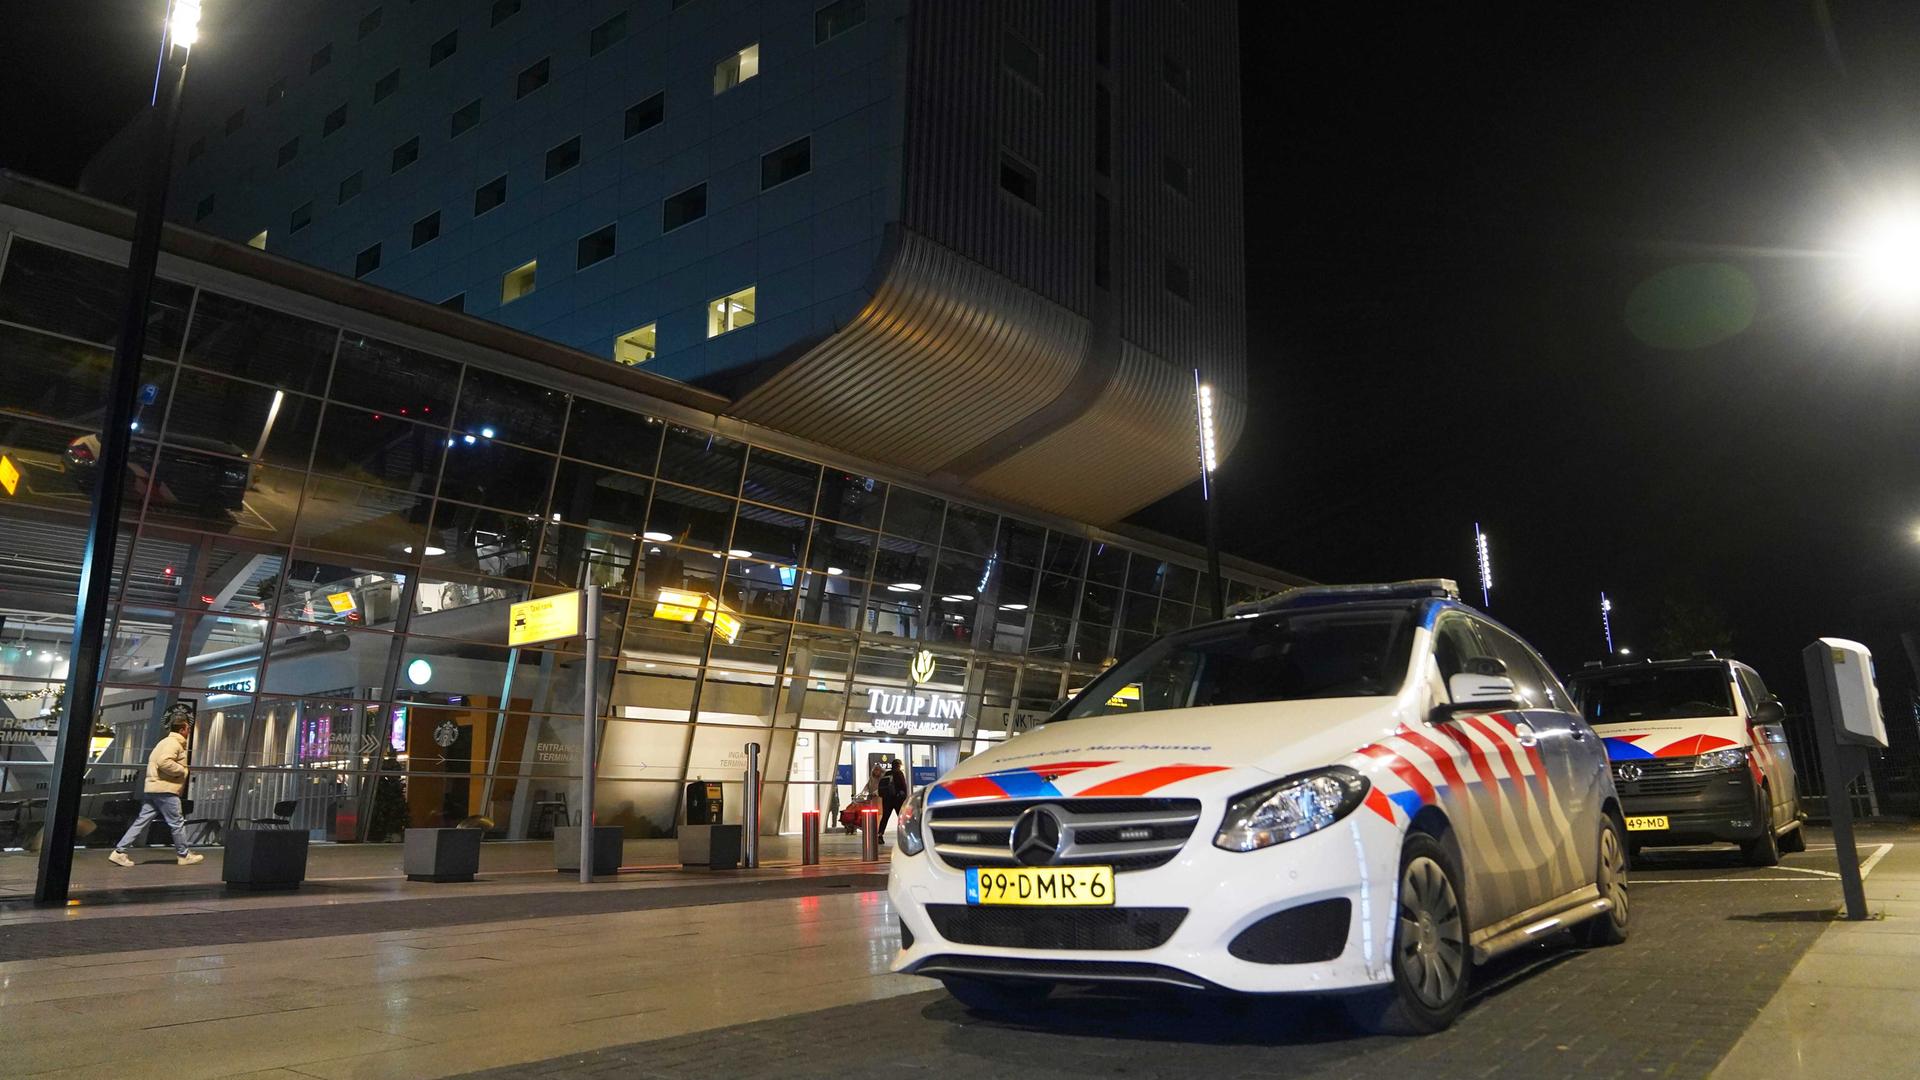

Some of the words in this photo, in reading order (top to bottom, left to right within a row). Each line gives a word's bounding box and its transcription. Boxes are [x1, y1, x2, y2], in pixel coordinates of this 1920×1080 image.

[868, 688, 925, 716] TULIP
[928, 694, 965, 719] INN
[875, 719, 918, 730] EINDHOVEN
[919, 723, 949, 731] AIRPORT
[981, 873, 1106, 899] 99-DMR-6
